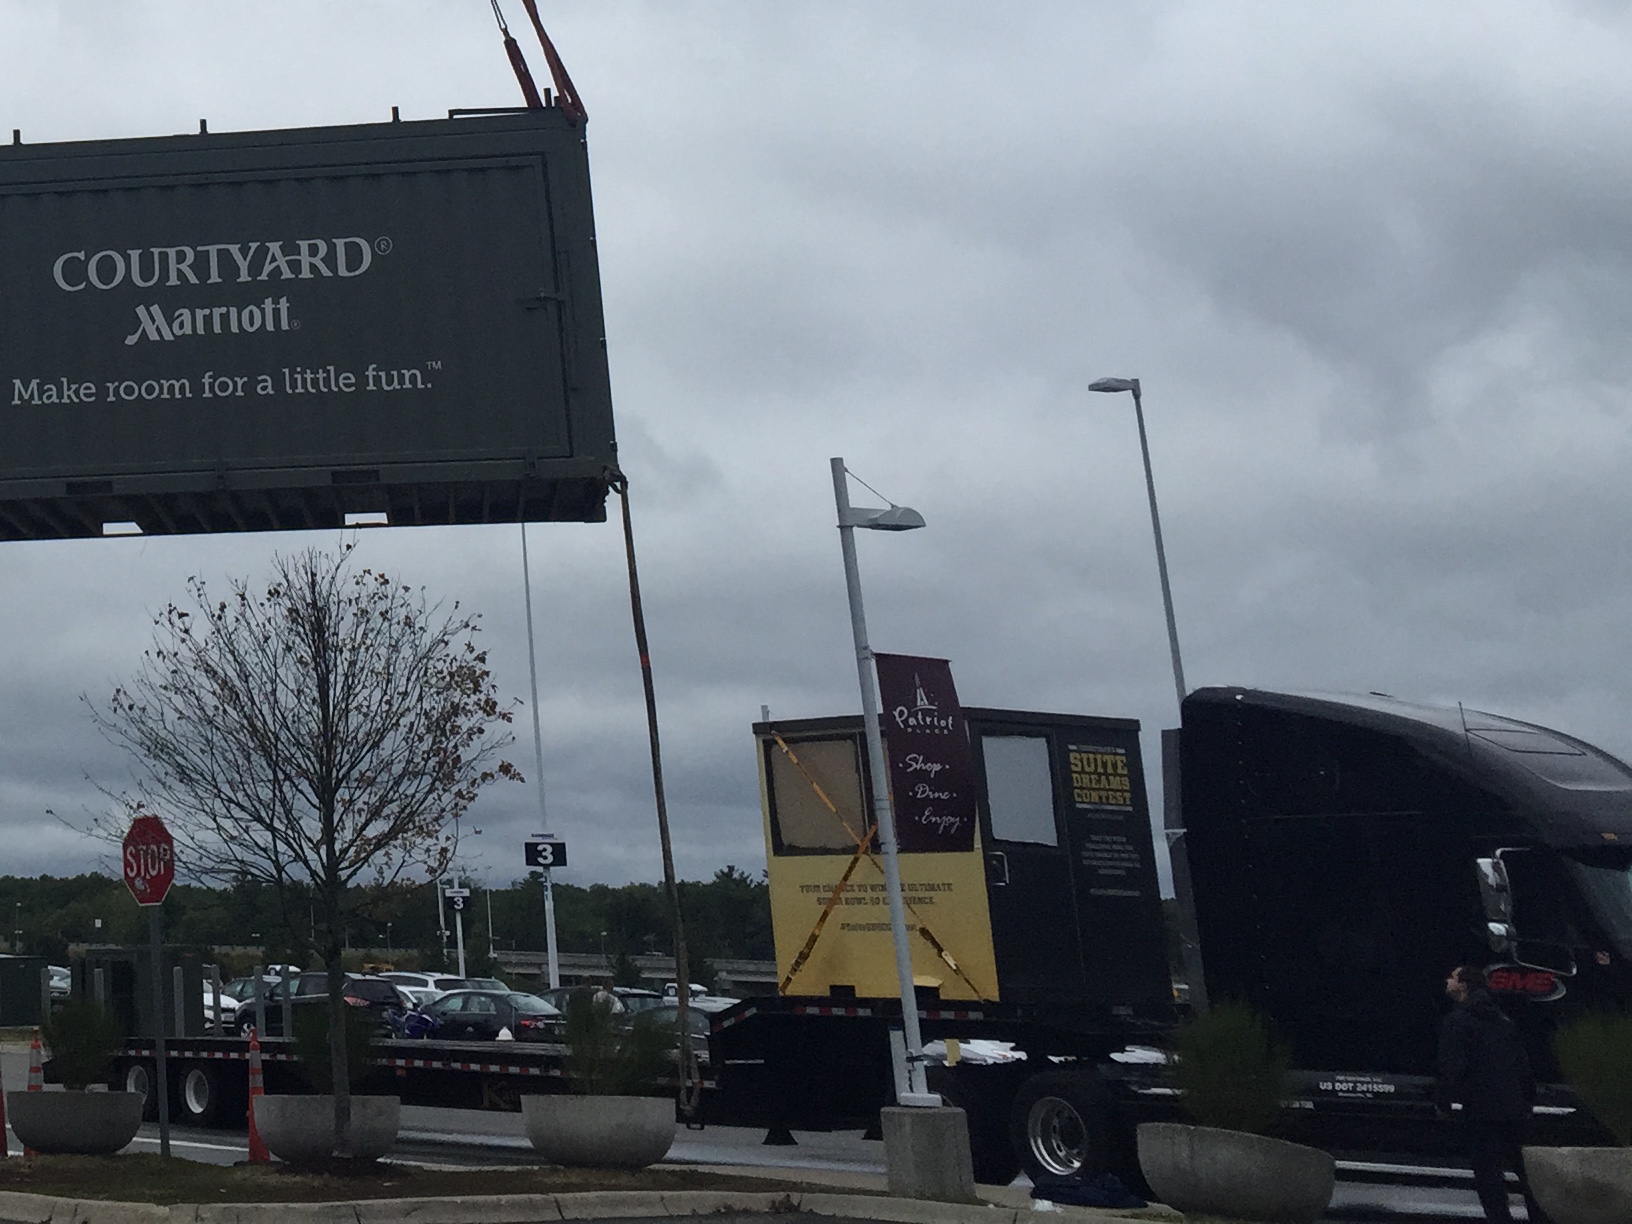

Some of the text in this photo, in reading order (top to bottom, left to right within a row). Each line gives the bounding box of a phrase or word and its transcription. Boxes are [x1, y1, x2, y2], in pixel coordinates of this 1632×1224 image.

[124, 295, 291, 347] Marriott
[10, 377, 97, 406] Make
[105, 379, 192, 402] room
[200, 371, 249, 398] for
[255, 375, 275, 395] a
[281, 364, 355, 394] little
[892, 706, 954, 731] Patriot
[905, 753, 943, 778] Shop
[1069, 752, 1128, 775] SUITE
[914, 783, 951, 800] Dine
[1072, 773, 1130, 791] DREAMS
[1073, 789, 1131, 805] CONTEST
[921, 807, 962, 834] Enjoy
[126, 843, 171, 878] STOP
[536, 843, 555, 865] 3
[453, 896, 464, 910] 3
[1319, 1081, 1333, 1091] US
[1334, 1082, 1354, 1092] DOT
